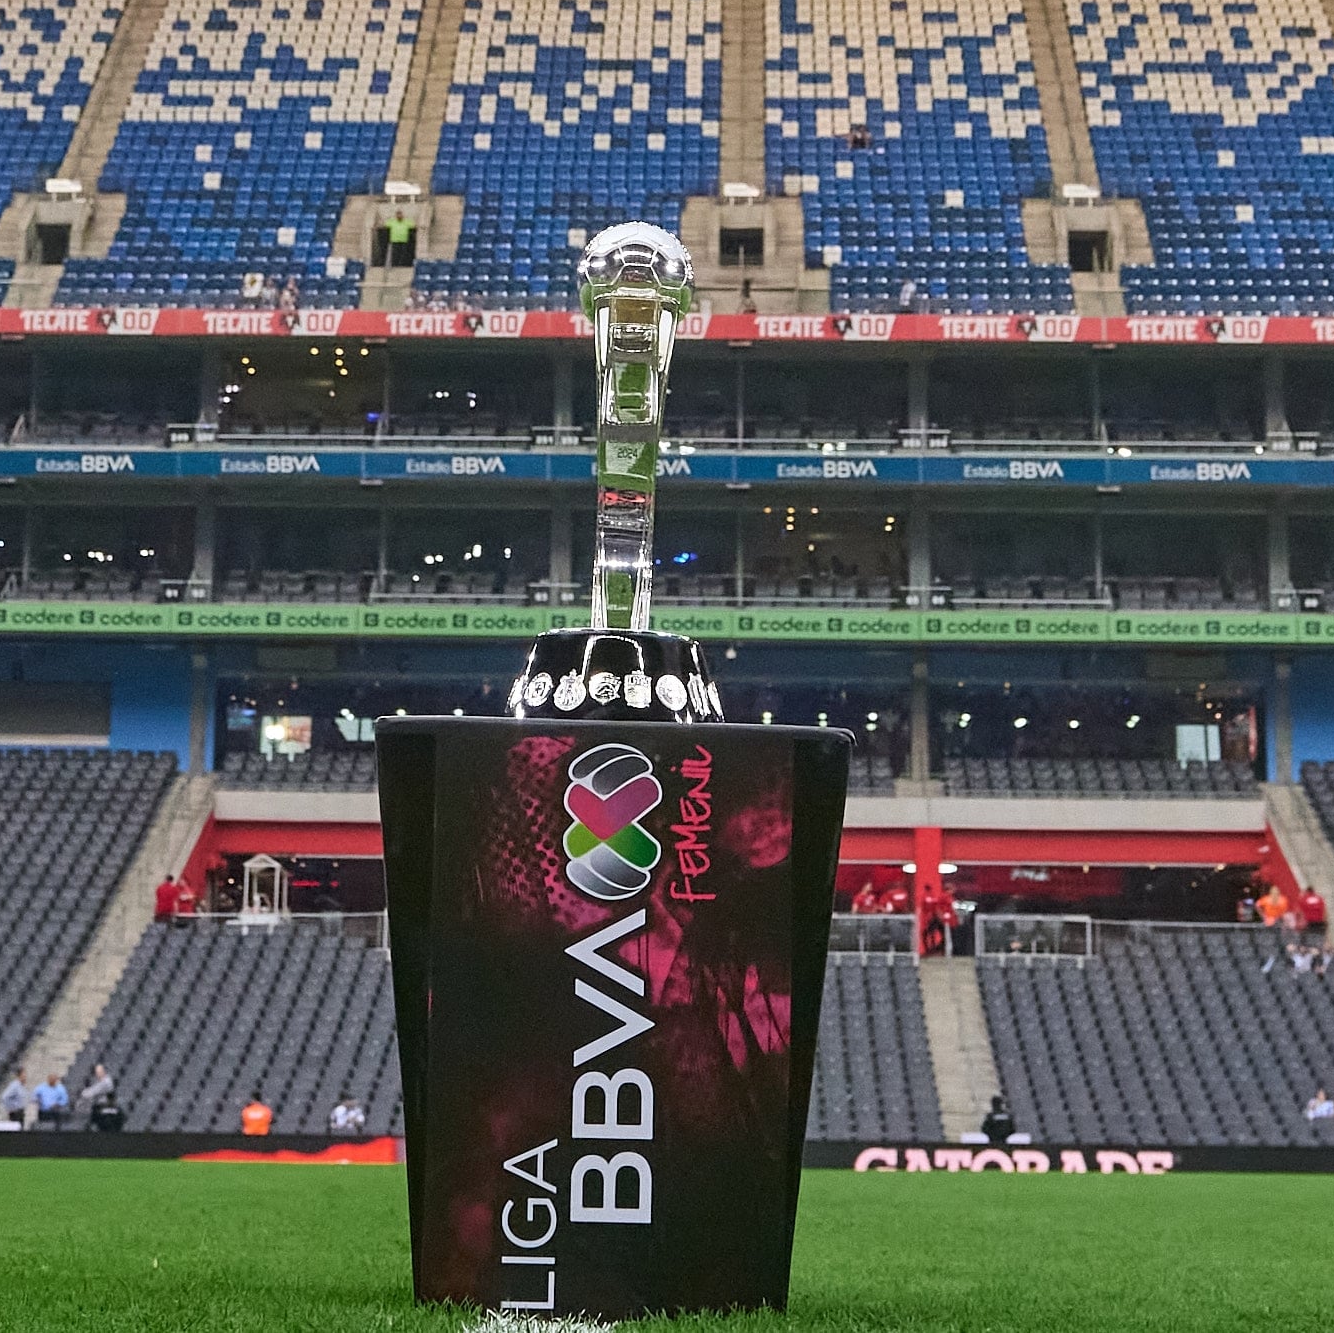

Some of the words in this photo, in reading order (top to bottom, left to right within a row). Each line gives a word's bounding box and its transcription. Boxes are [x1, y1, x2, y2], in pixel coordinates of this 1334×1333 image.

[19, 310, 91, 331] TECATE
[202, 311, 275, 332] TECATE
[385, 313, 457, 334] TECATE
[754, 315, 826, 336] TECATE
[938, 317, 1011, 338] TECATE
[1126, 318, 1199, 339] TECATE
[617, 448, 638, 459] 2024
[80, 454, 135, 472] BBVA
[221, 457, 264, 472] Estadio
[265, 455, 320, 473] BBVA
[407, 458, 450, 473] Estadio
[451, 456, 506, 474] BBVA
[655, 460, 691, 477] BVA
[823, 459, 878, 477] BBVA
[1009, 460, 1064, 478] BBVA
[1196, 462, 1251, 480] BBVA
[287, 612, 349, 628] codere
[384, 612, 446, 629] codere
[473, 613, 535, 630] codere
[660, 615, 722, 632] codere
[759, 616, 821, 633] codere
[848, 617, 910, 634] codere
[564, 908, 655, 1225] BBVA
[854, 1147, 1174, 1174] GATORADE
[501, 1139, 558, 1311] LIGA
